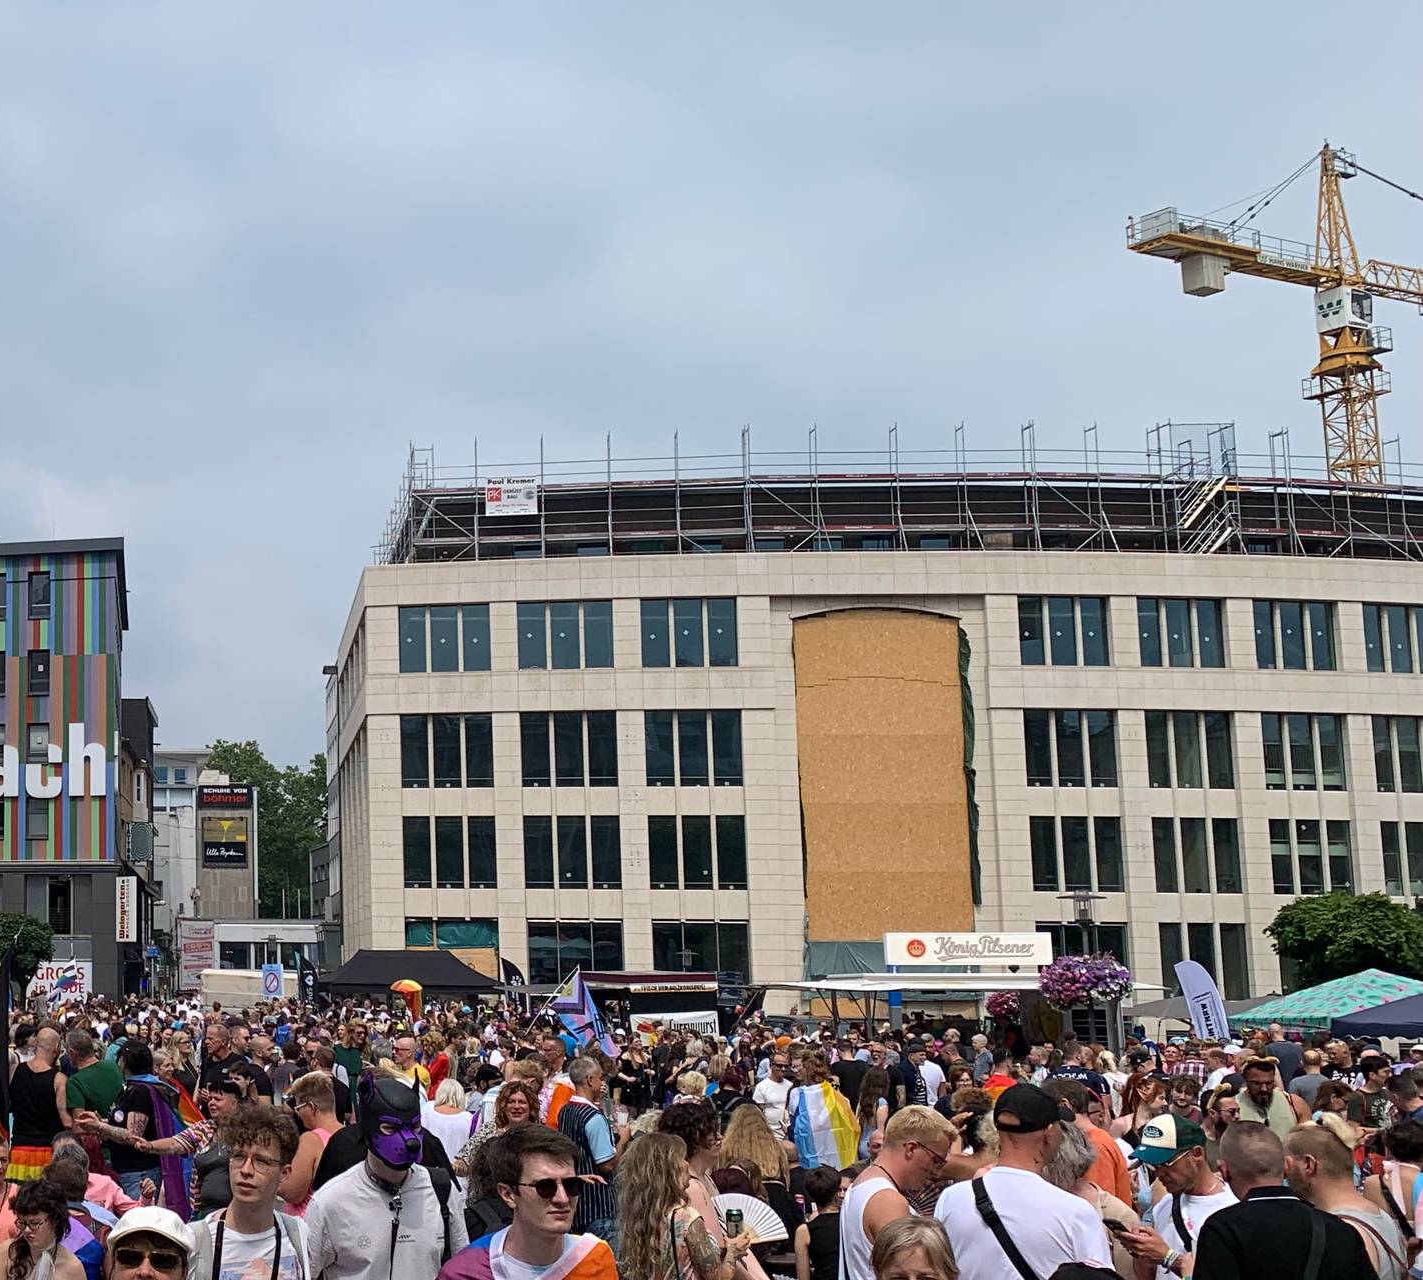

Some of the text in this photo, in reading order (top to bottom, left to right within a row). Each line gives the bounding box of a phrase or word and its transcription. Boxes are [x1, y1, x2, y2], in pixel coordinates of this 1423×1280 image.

[203, 794, 248, 803] böhmer
[934, 935, 1035, 957] König Pilsener
